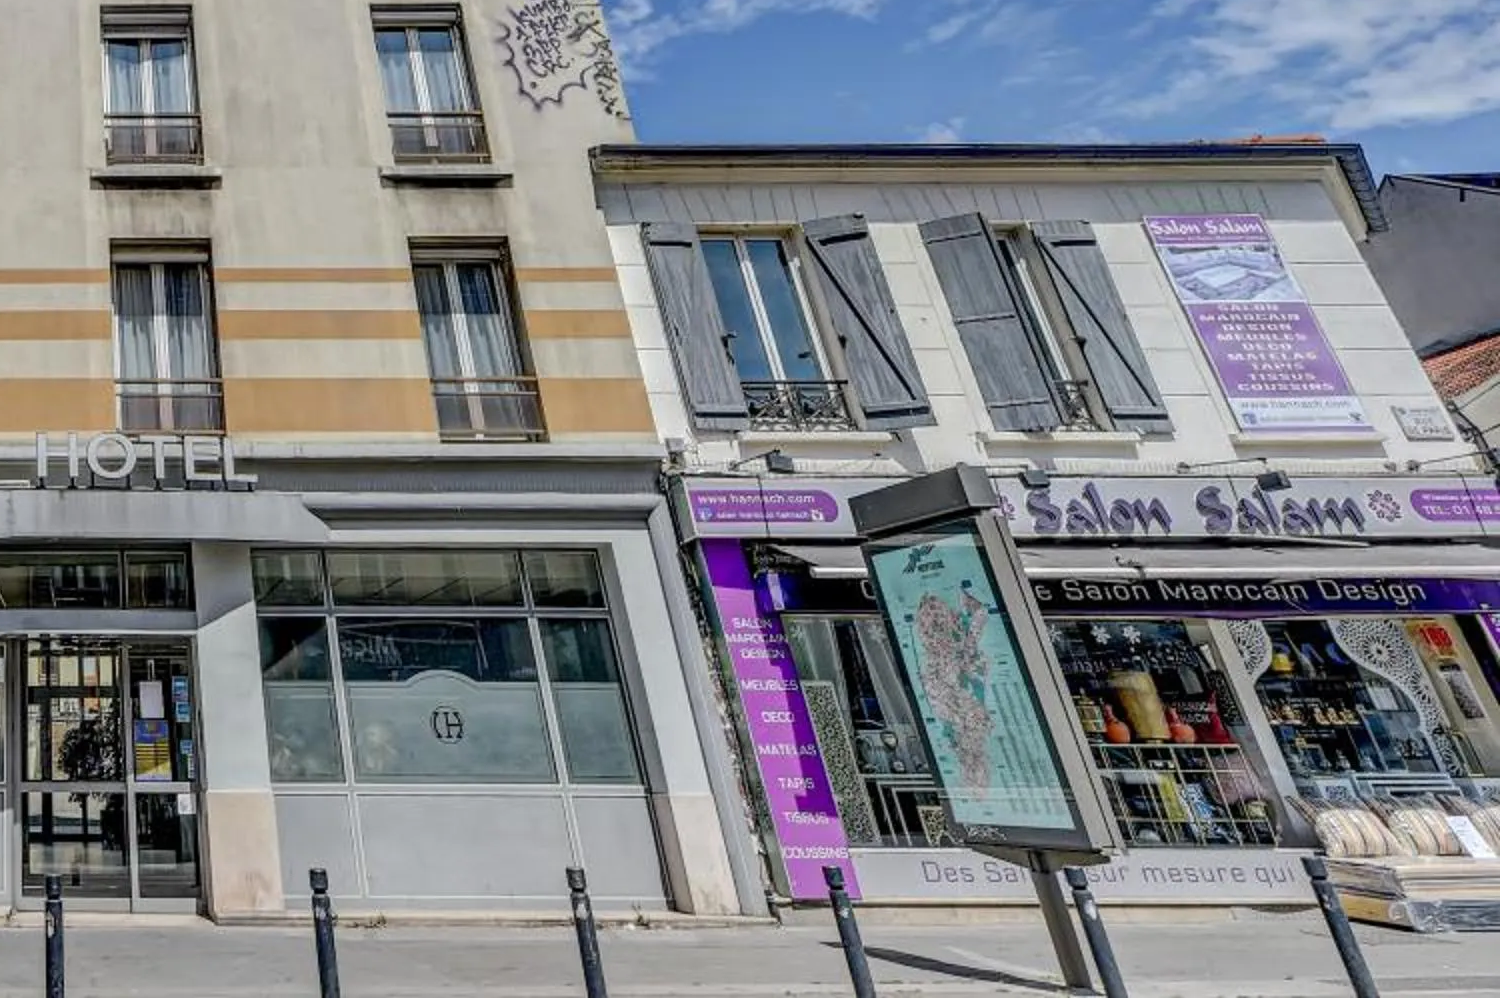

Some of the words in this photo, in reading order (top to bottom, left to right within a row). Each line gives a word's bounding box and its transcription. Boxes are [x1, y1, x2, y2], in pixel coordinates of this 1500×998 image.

[1150, 219, 1201, 235] Salon
[1204, 218, 1264, 235] Salam
[36, 432, 258, 484] HOTEL
[1026, 481, 1173, 535] Salon
[1196, 484, 1366, 535] Salam
[1161, 579, 1309, 601] Marocain
[1318, 579, 1426, 605] Design
[732, 617, 773, 630] SALON
[725, 632, 788, 644] MAROCAIN
[740, 678, 799, 692] MEUBLES
[758, 744, 818, 756] MATELAS
[777, 777, 816, 790] TAPIS
[782, 811, 830, 825] TISSUS
[783, 847, 849, 859] COUSSINS
[921, 860, 975, 884] Des
[1089, 865, 1128, 884] sur
[1142, 866, 1246, 884] mesure
[1254, 860, 1295, 889] qui
